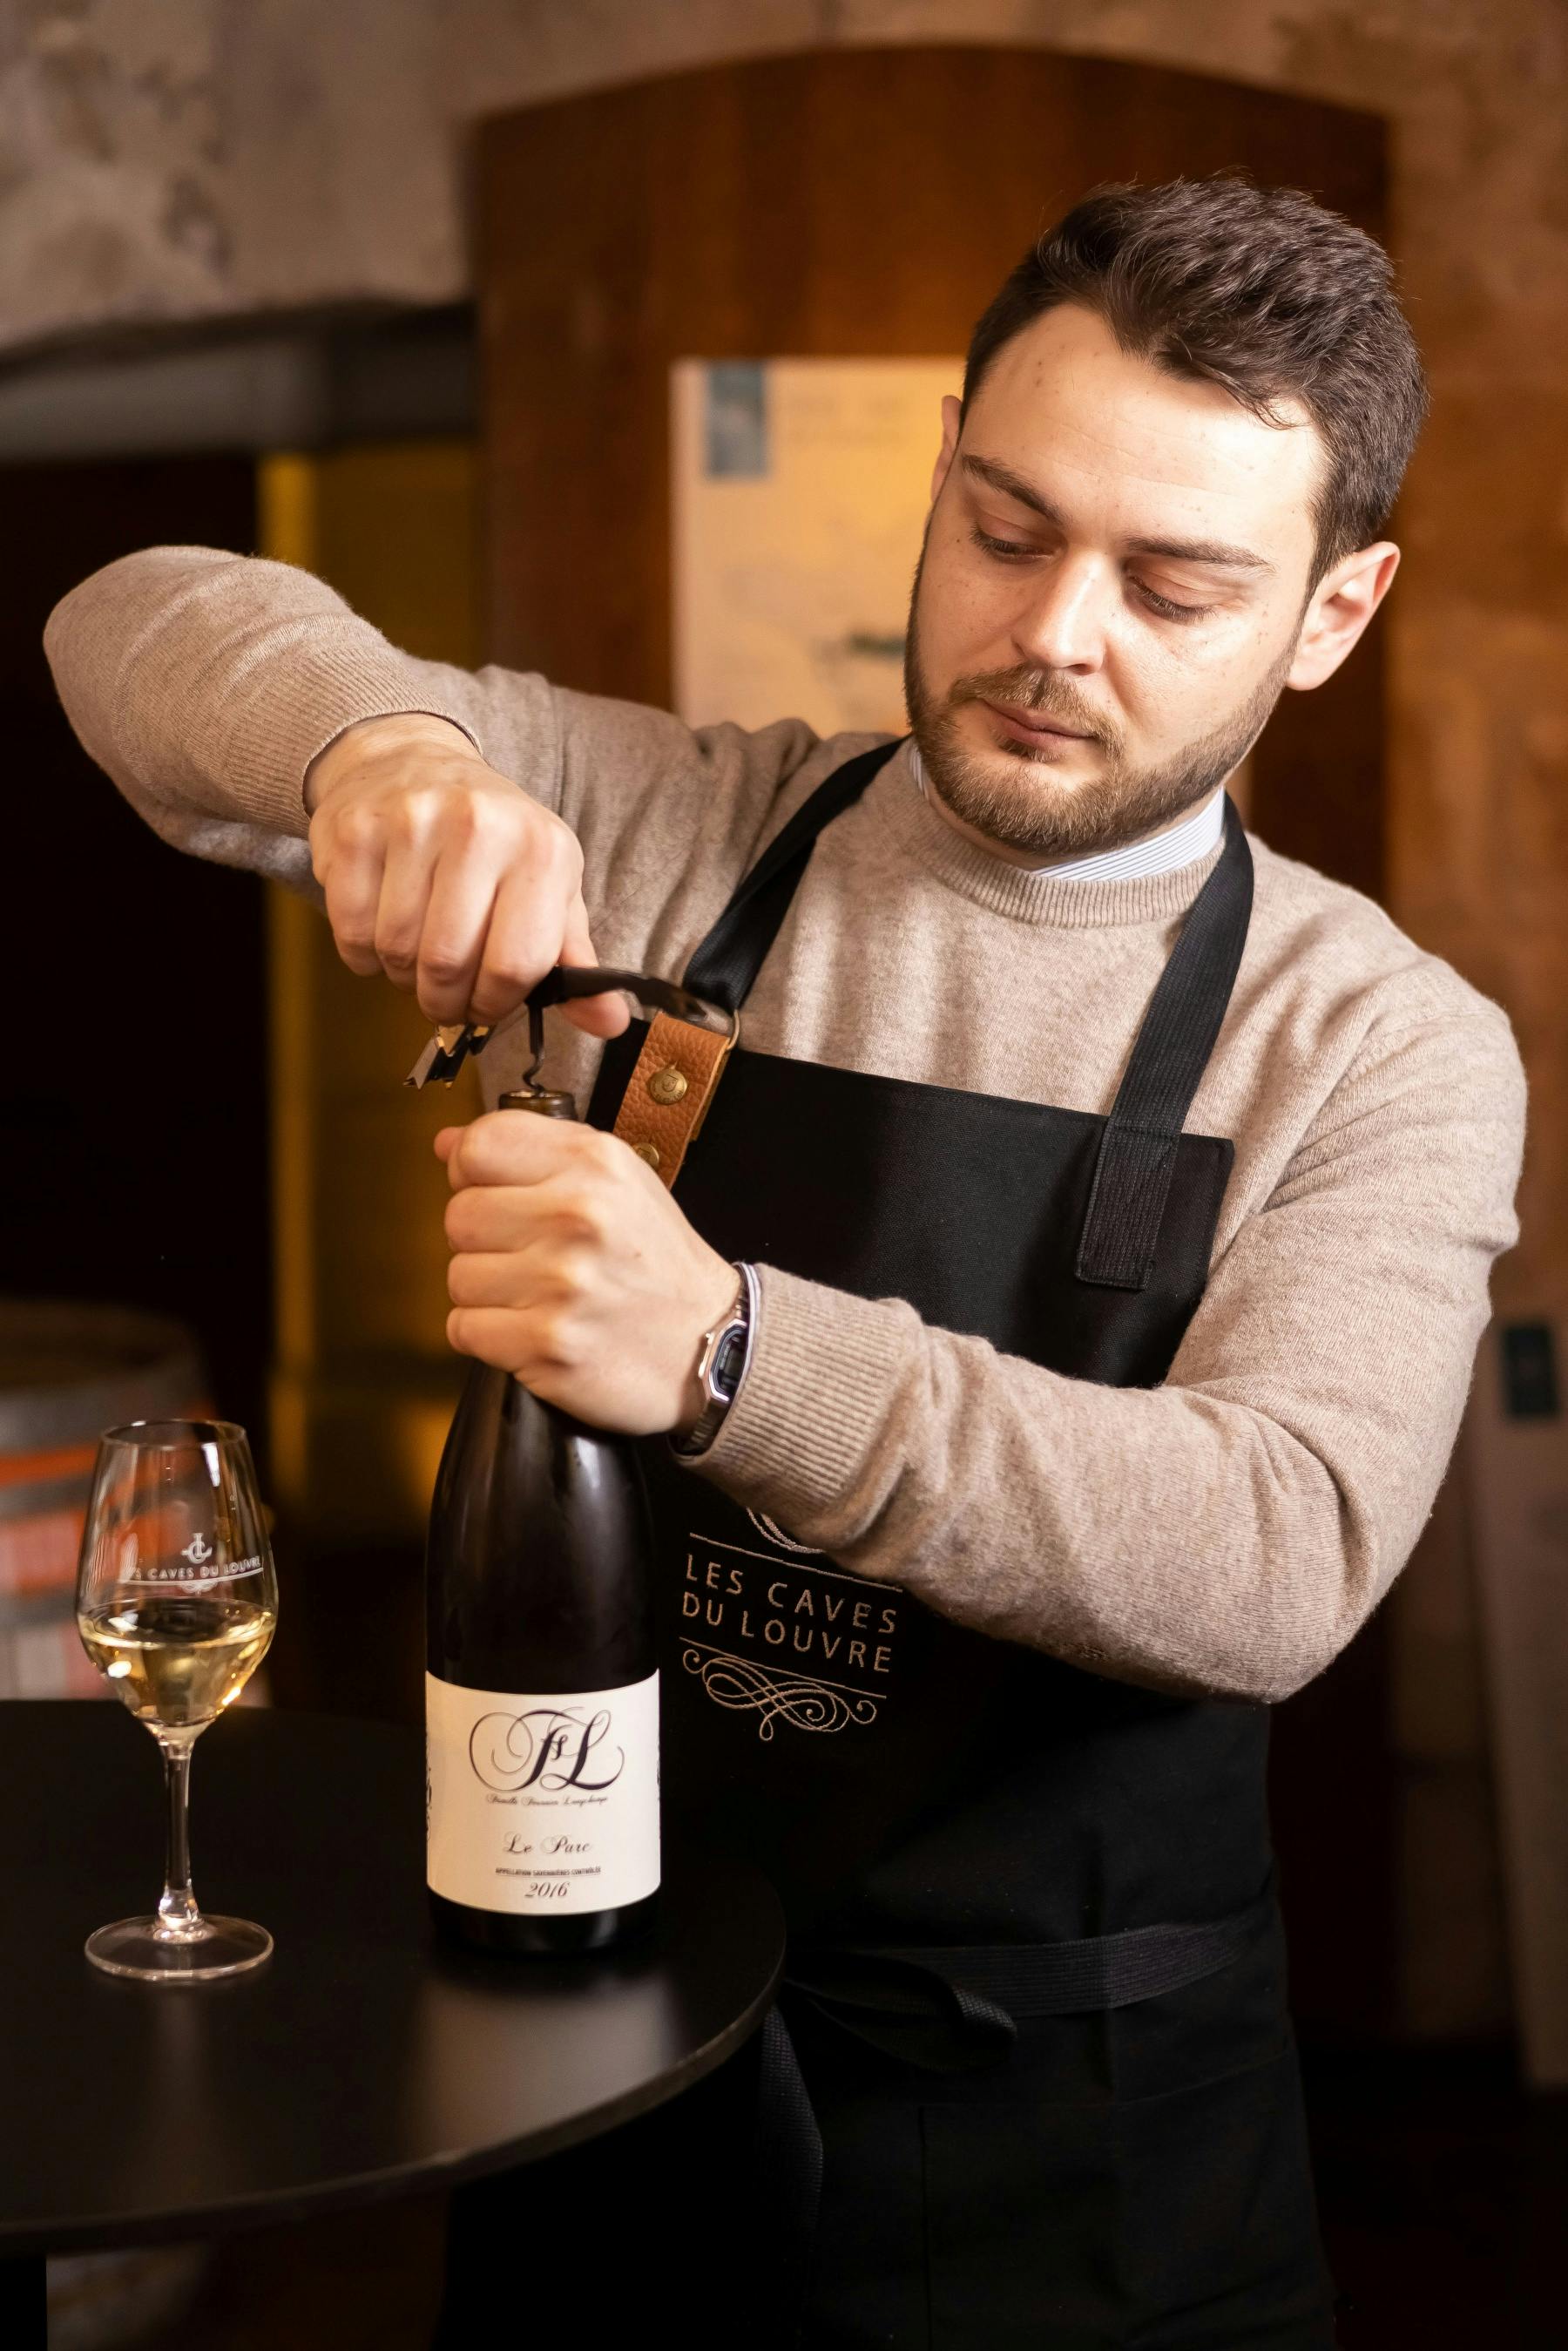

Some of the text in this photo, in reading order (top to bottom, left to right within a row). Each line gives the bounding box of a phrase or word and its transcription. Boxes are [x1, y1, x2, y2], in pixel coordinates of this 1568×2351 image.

[147, 1568, 194, 1580] CAVES
[199, 1566, 219, 1578] DU
[686, 1554, 896, 1633] LES CAVES
[683, 1591, 892, 1672] DU LOUVRE
[504, 1831, 591, 1854] Le Parc
[524, 1881, 570, 1898] 2016
